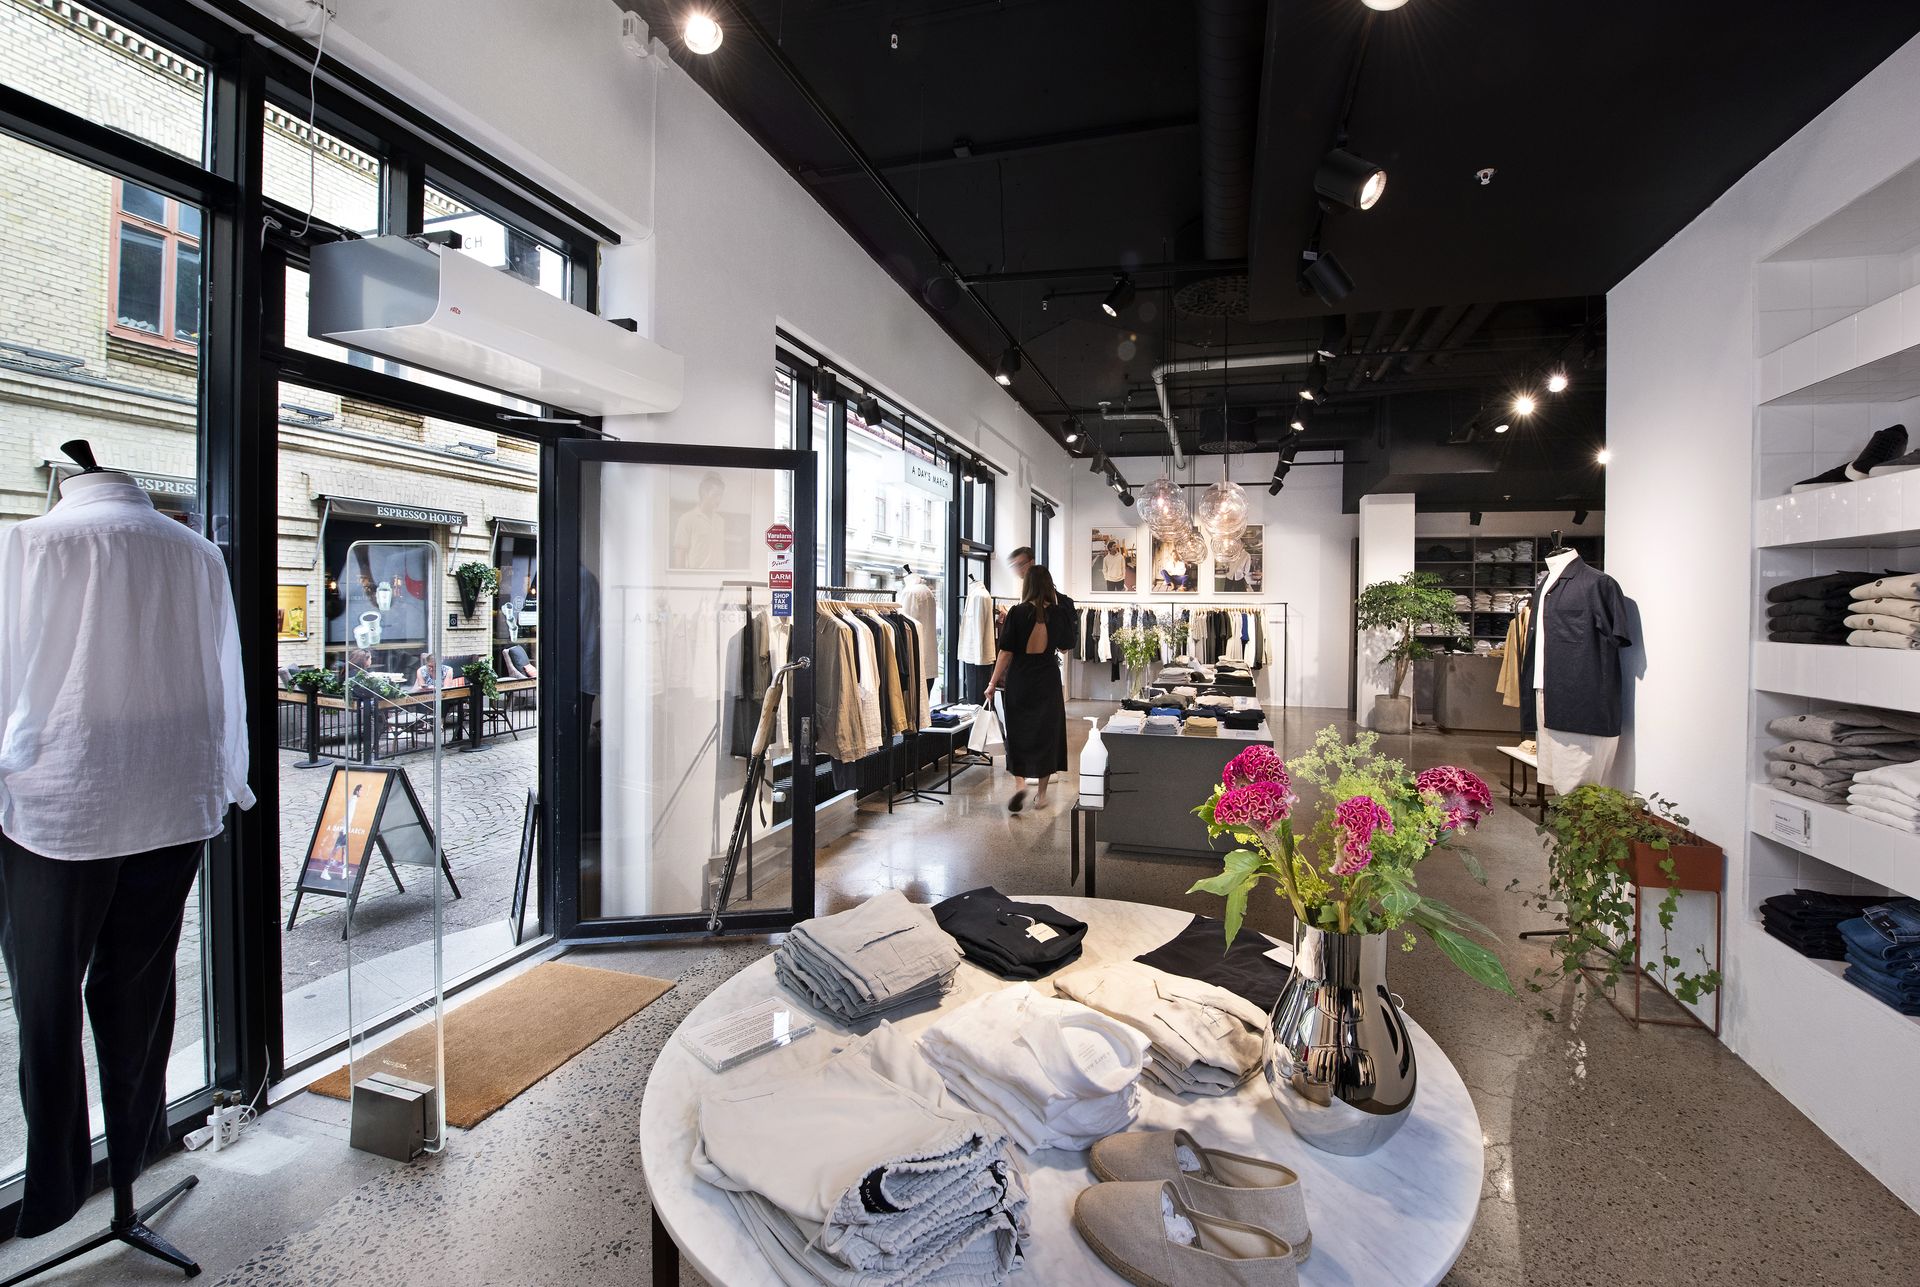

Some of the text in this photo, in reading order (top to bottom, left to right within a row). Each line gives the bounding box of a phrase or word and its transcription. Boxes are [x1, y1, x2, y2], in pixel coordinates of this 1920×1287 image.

[464, 235, 483, 250] CH
[134, 477, 197, 495] ESPRES
[917, 468, 931, 482] DAY'S
[932, 475, 949, 488] MARCH
[376, 506, 463, 525] ESPRESSO HOUSE
